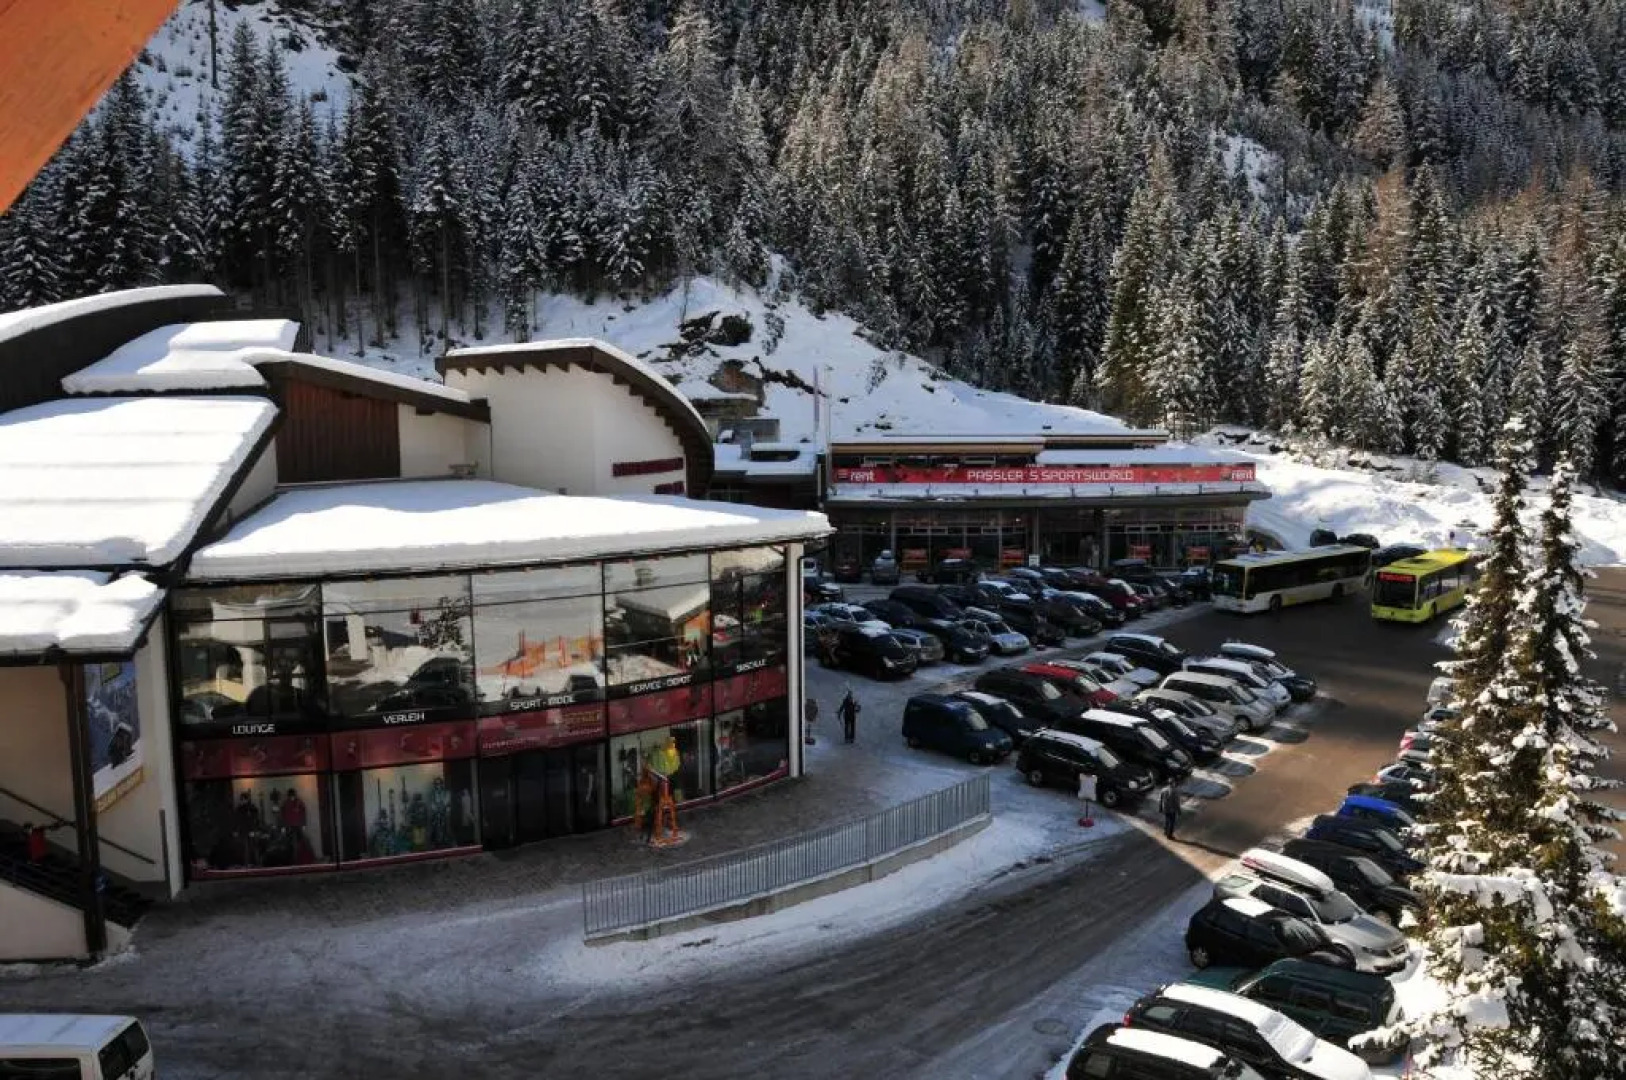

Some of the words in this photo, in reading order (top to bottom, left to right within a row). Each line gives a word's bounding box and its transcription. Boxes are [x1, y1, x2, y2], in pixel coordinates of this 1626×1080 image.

[851, 470, 875, 482] rent
[1041, 470, 1134, 481] SPORTSWORLD
[510, 699, 541, 711] SPORT
[232, 723, 276, 735] LOUNGE
